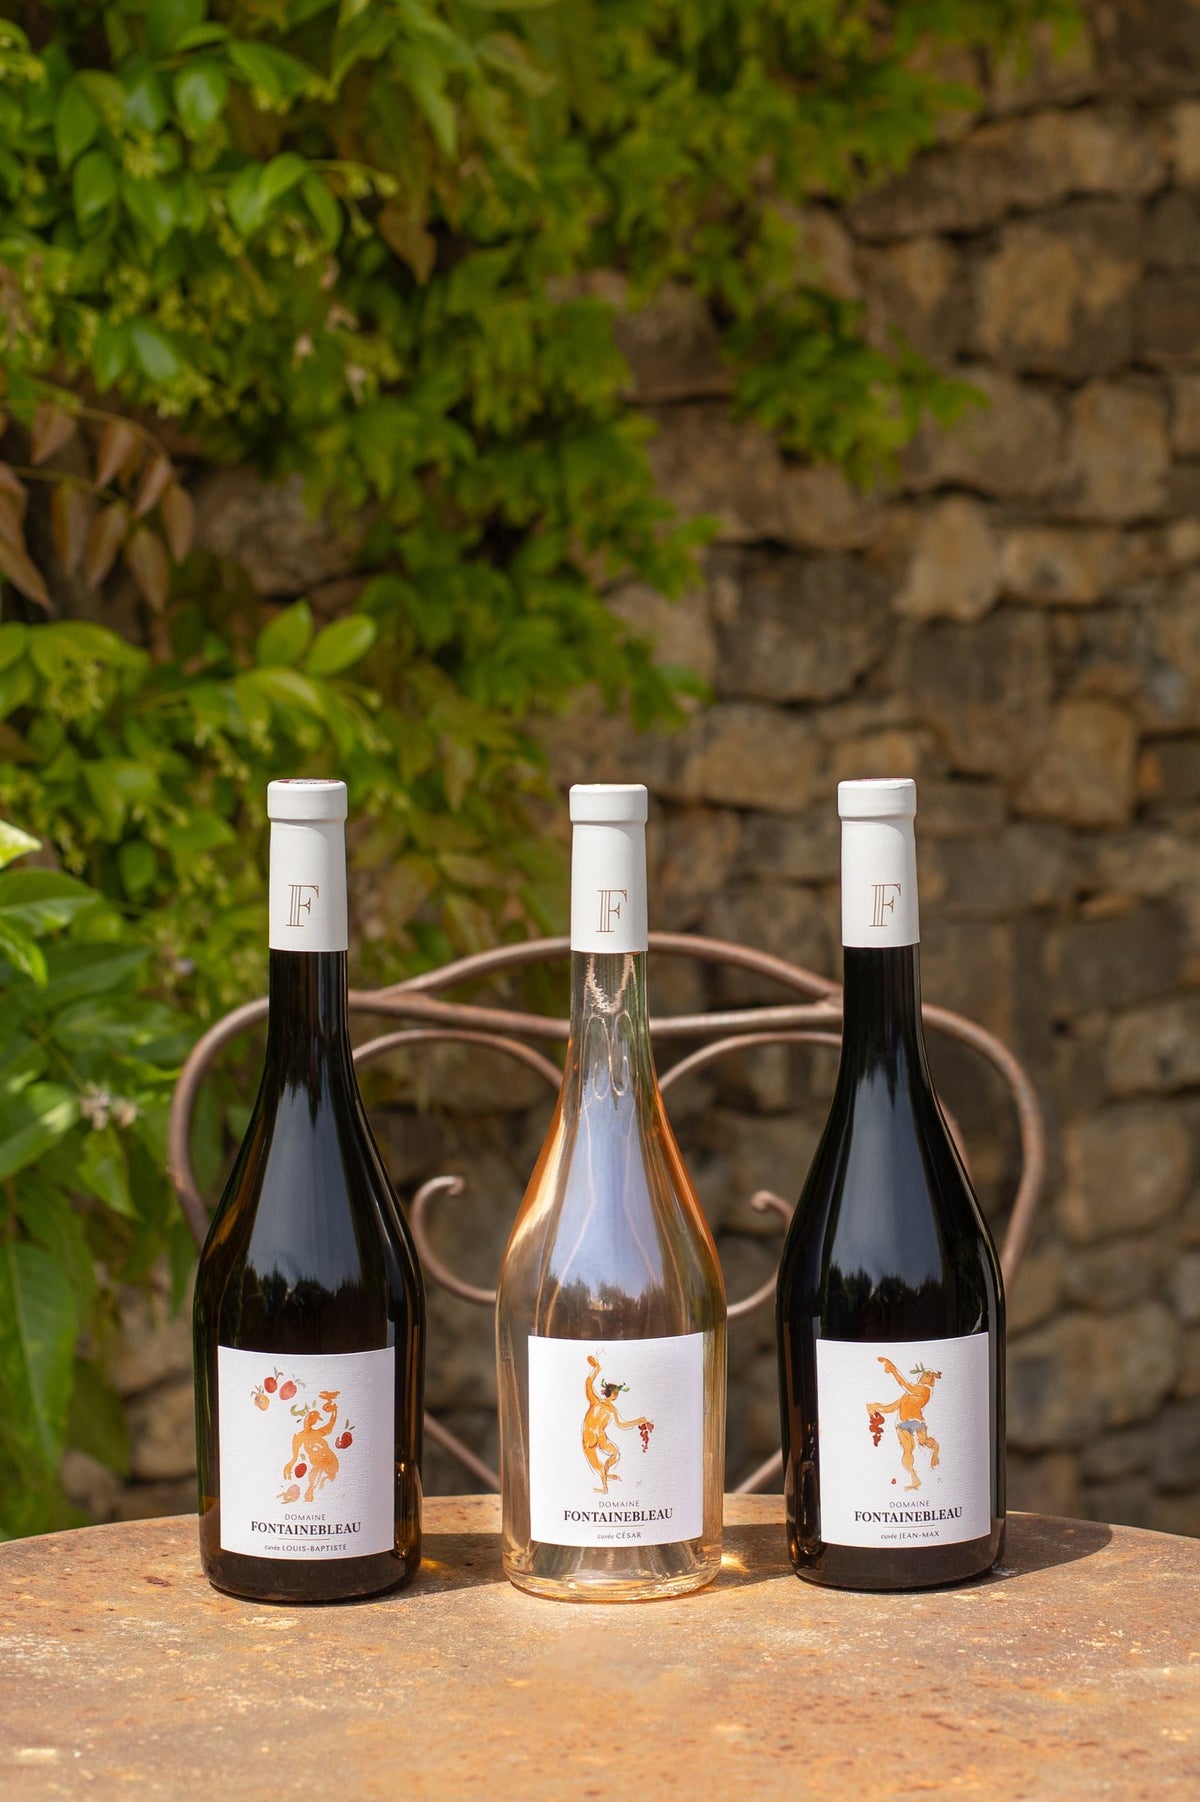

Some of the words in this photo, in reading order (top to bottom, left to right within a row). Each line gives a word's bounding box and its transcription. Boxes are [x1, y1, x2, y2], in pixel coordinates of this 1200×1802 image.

[286, 884, 319, 927] F
[595, 889, 628, 933] F
[868, 883, 901, 927] F
[598, 1500, 640, 1508] DOMAINE
[889, 1500, 930, 1508] DOMAINE
[284, 1513, 326, 1521] DOMAINE
[564, 1508, 673, 1522] FONTAINEBLEAU
[854, 1507, 963, 1523] FONTAINEBLEAU
[251, 1521, 361, 1535] FONTAINEBLEAU
[597, 1532, 615, 1540] cuvée
[616, 1531, 642, 1540] CÉSAR
[899, 1530, 940, 1540] JEAN-MAX
[282, 1544, 347, 1552] LOUIS-BAPTISTE
